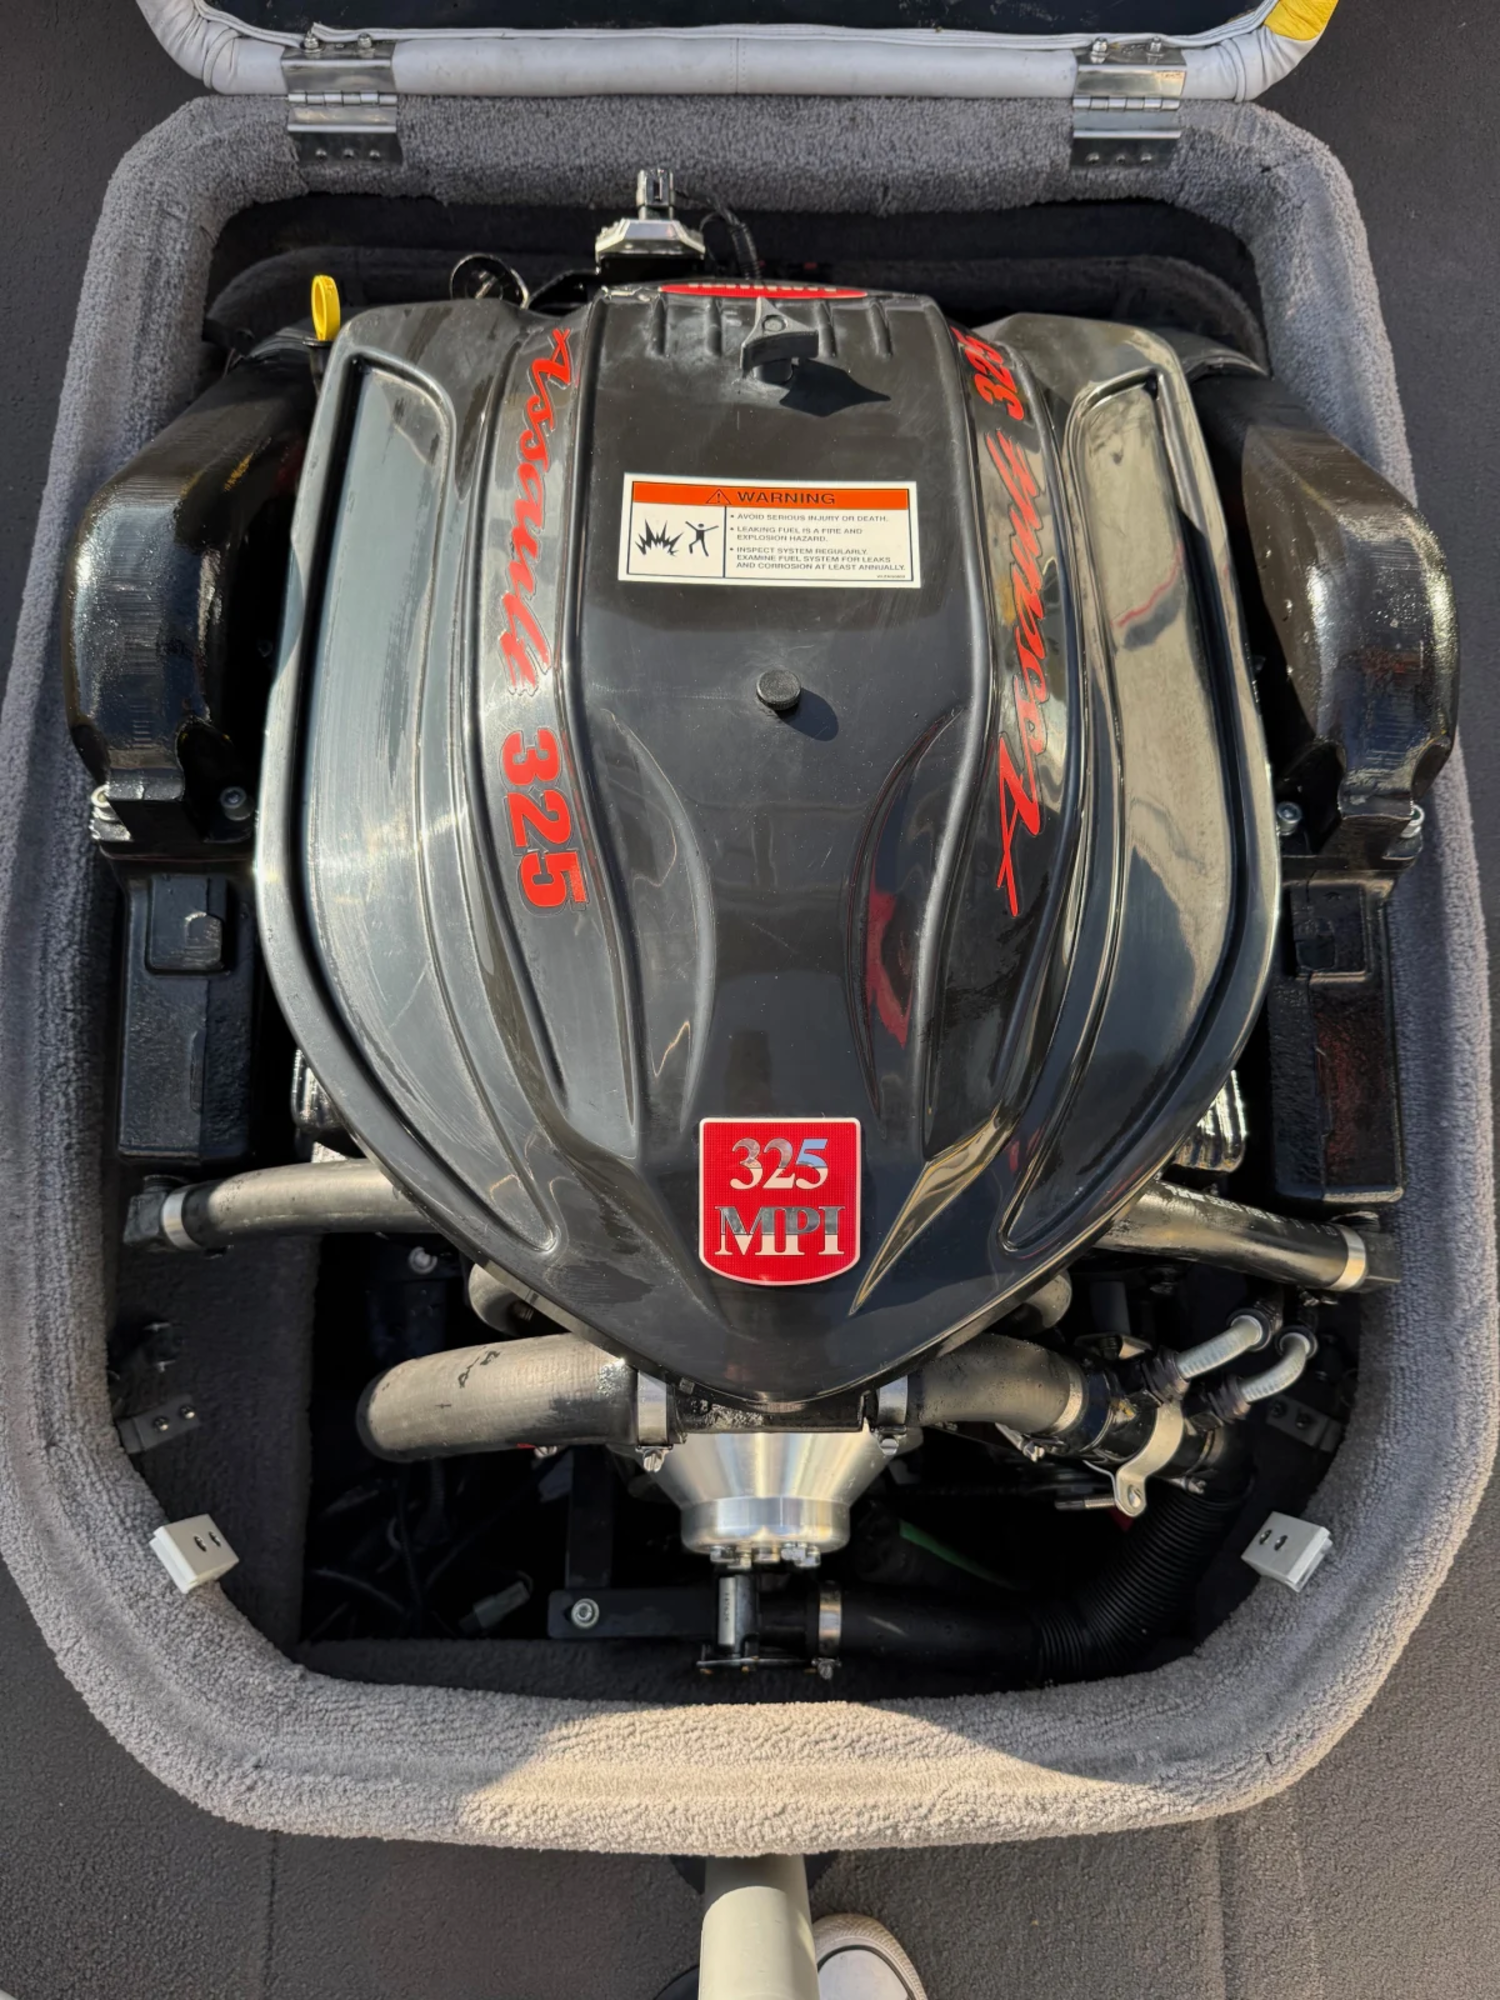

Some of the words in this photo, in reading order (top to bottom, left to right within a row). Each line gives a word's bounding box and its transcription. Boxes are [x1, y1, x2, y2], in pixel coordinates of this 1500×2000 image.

[950, 326, 1024, 421] 325
[498, 328, 571, 693] Assault
[737, 491, 836, 505] WARNING
[737, 513, 765, 521] AVOID
[808, 514, 840, 522] INJURY
[757, 562, 813, 570] CORROSION
[986, 428, 1047, 917] Assault
[501, 727, 588, 910] 325
[729, 1137, 829, 1190] 325
[714, 1205, 846, 1256] MPI
